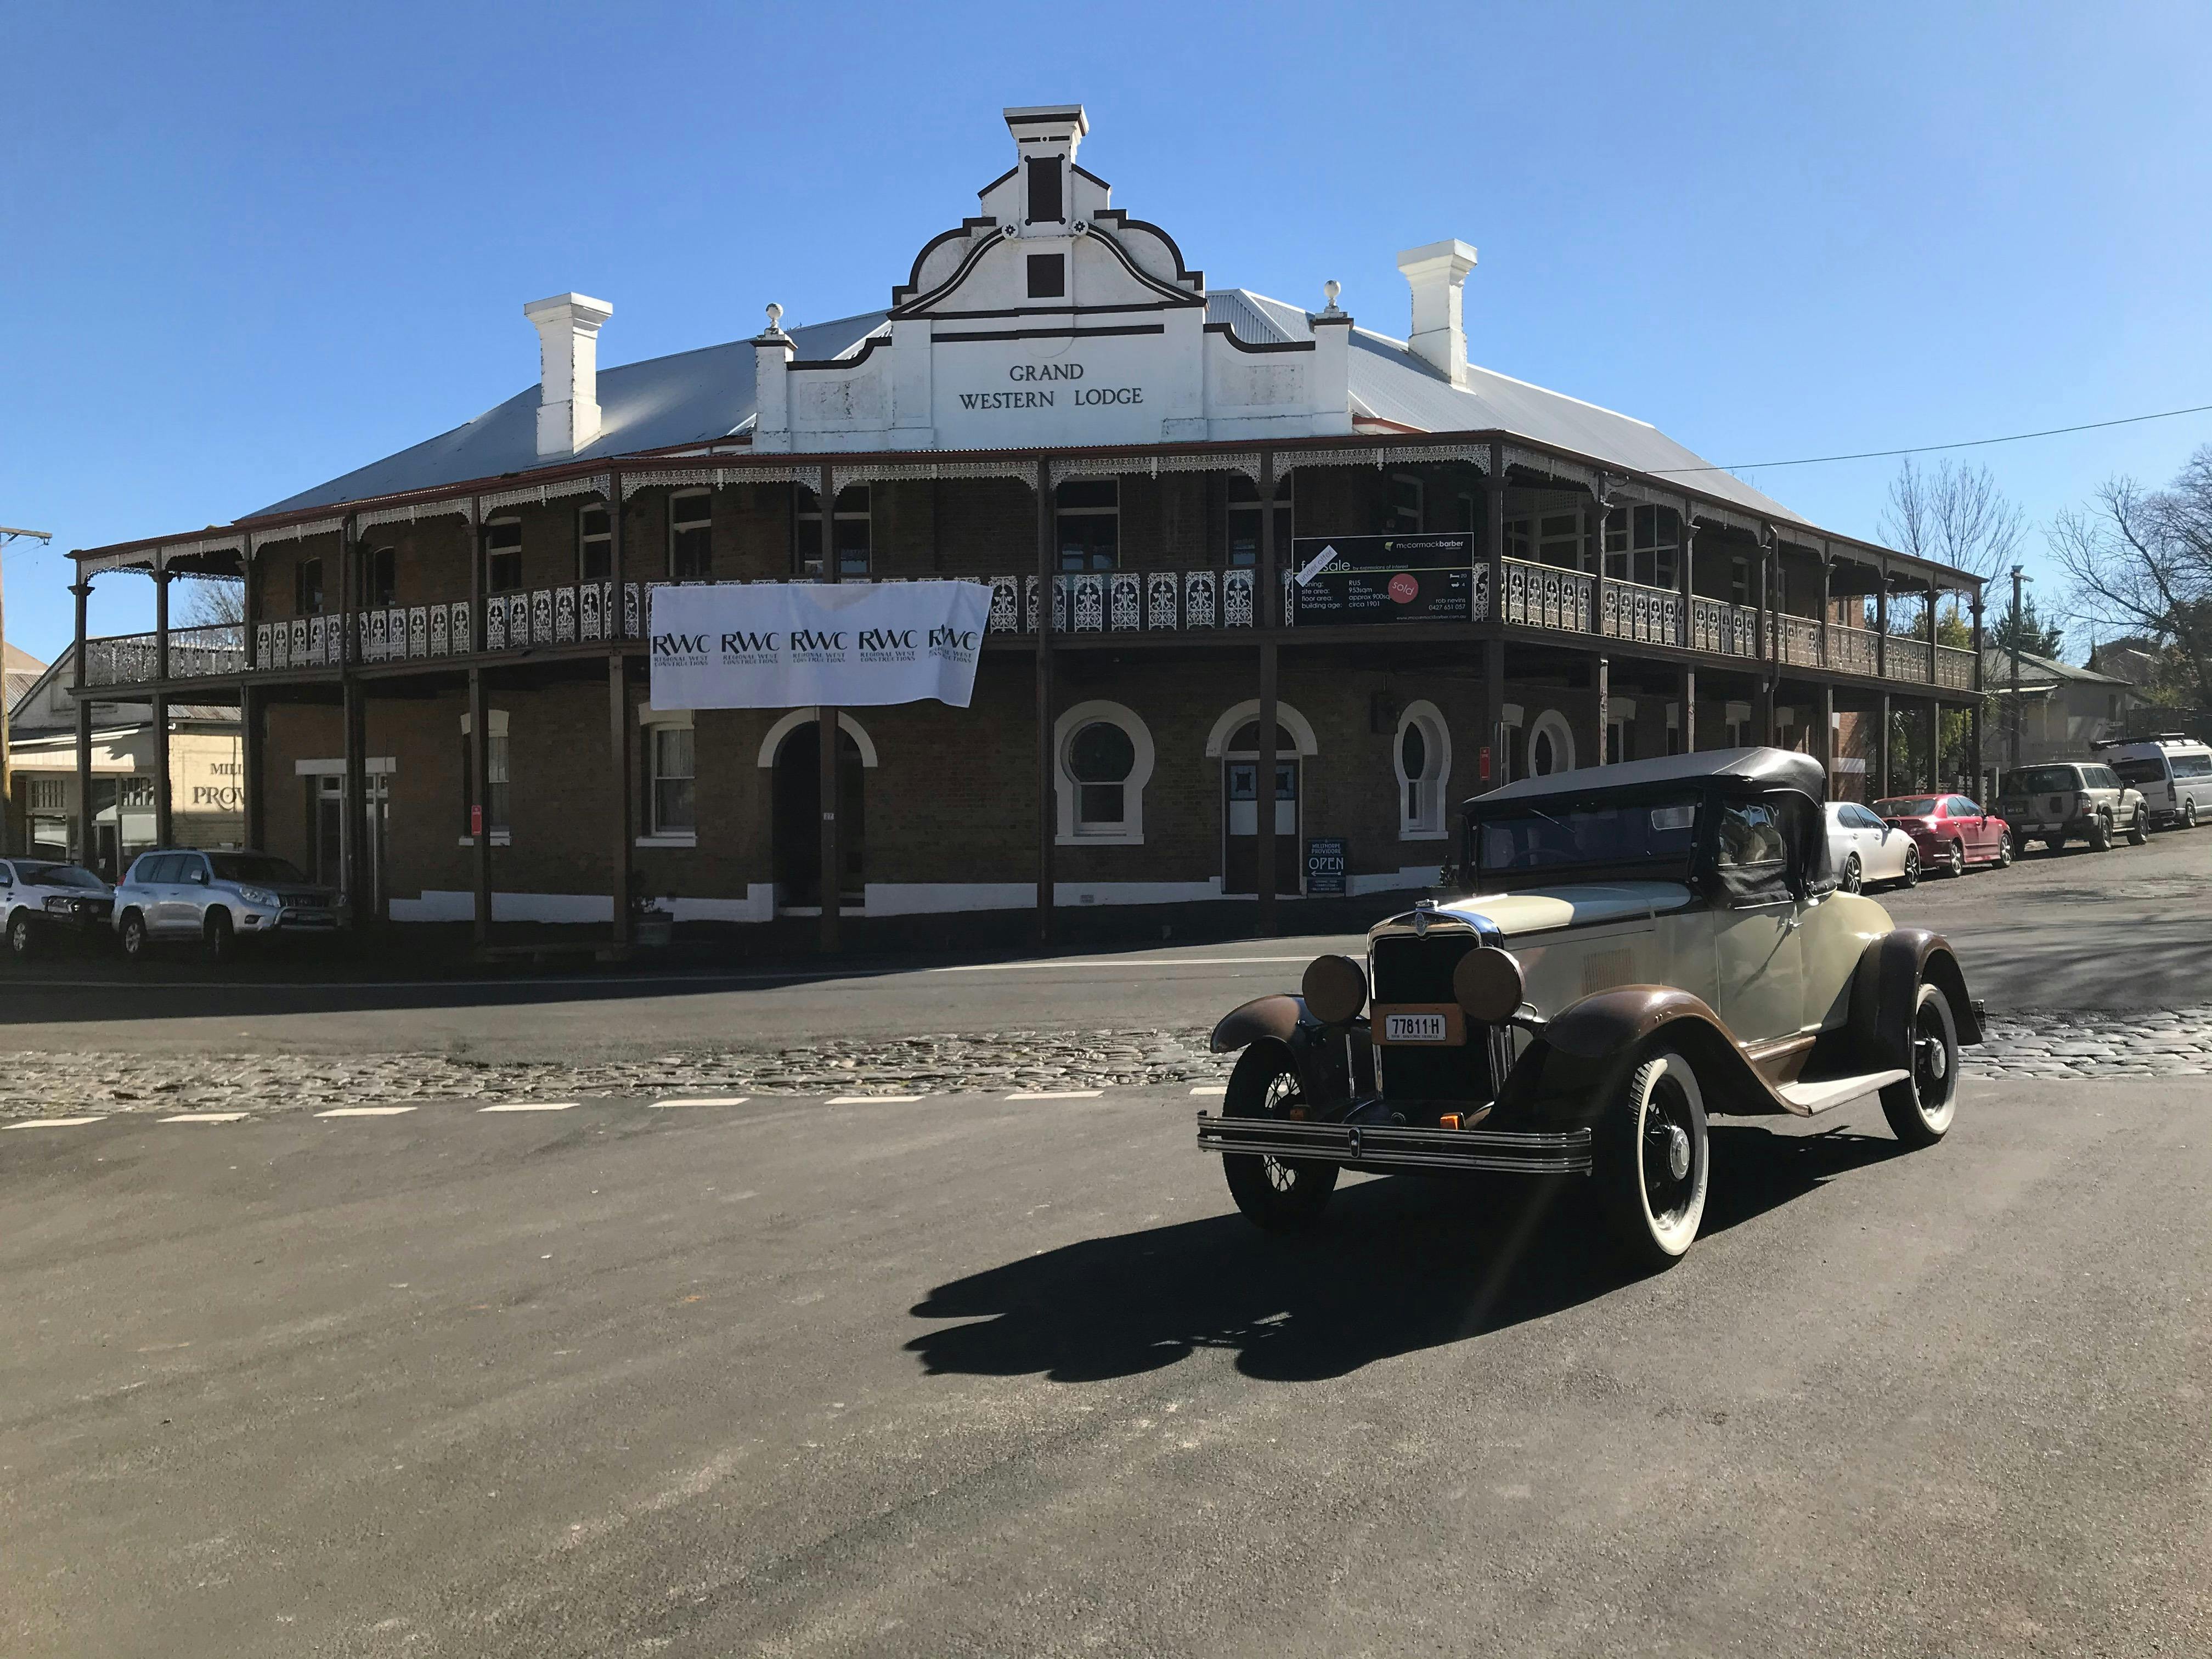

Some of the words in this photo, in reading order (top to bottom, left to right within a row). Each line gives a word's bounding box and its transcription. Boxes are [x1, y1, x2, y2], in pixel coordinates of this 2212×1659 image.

[1009, 363, 1084, 382] GRAND
[958, 391, 1054, 410] WESTERN
[1074, 387, 1144, 407] LODGE
[1317, 549, 1333, 566] offer
[1323, 560, 1351, 572] sale
[1392, 581, 1415, 596] sold
[652, 633, 711, 657] RWC
[721, 631, 780, 654] RWC
[791, 629, 848, 652] RWC
[859, 628, 918, 652] RWC
[929, 624, 978, 651] RWC
[1308, 857, 1344, 870] OPEN
